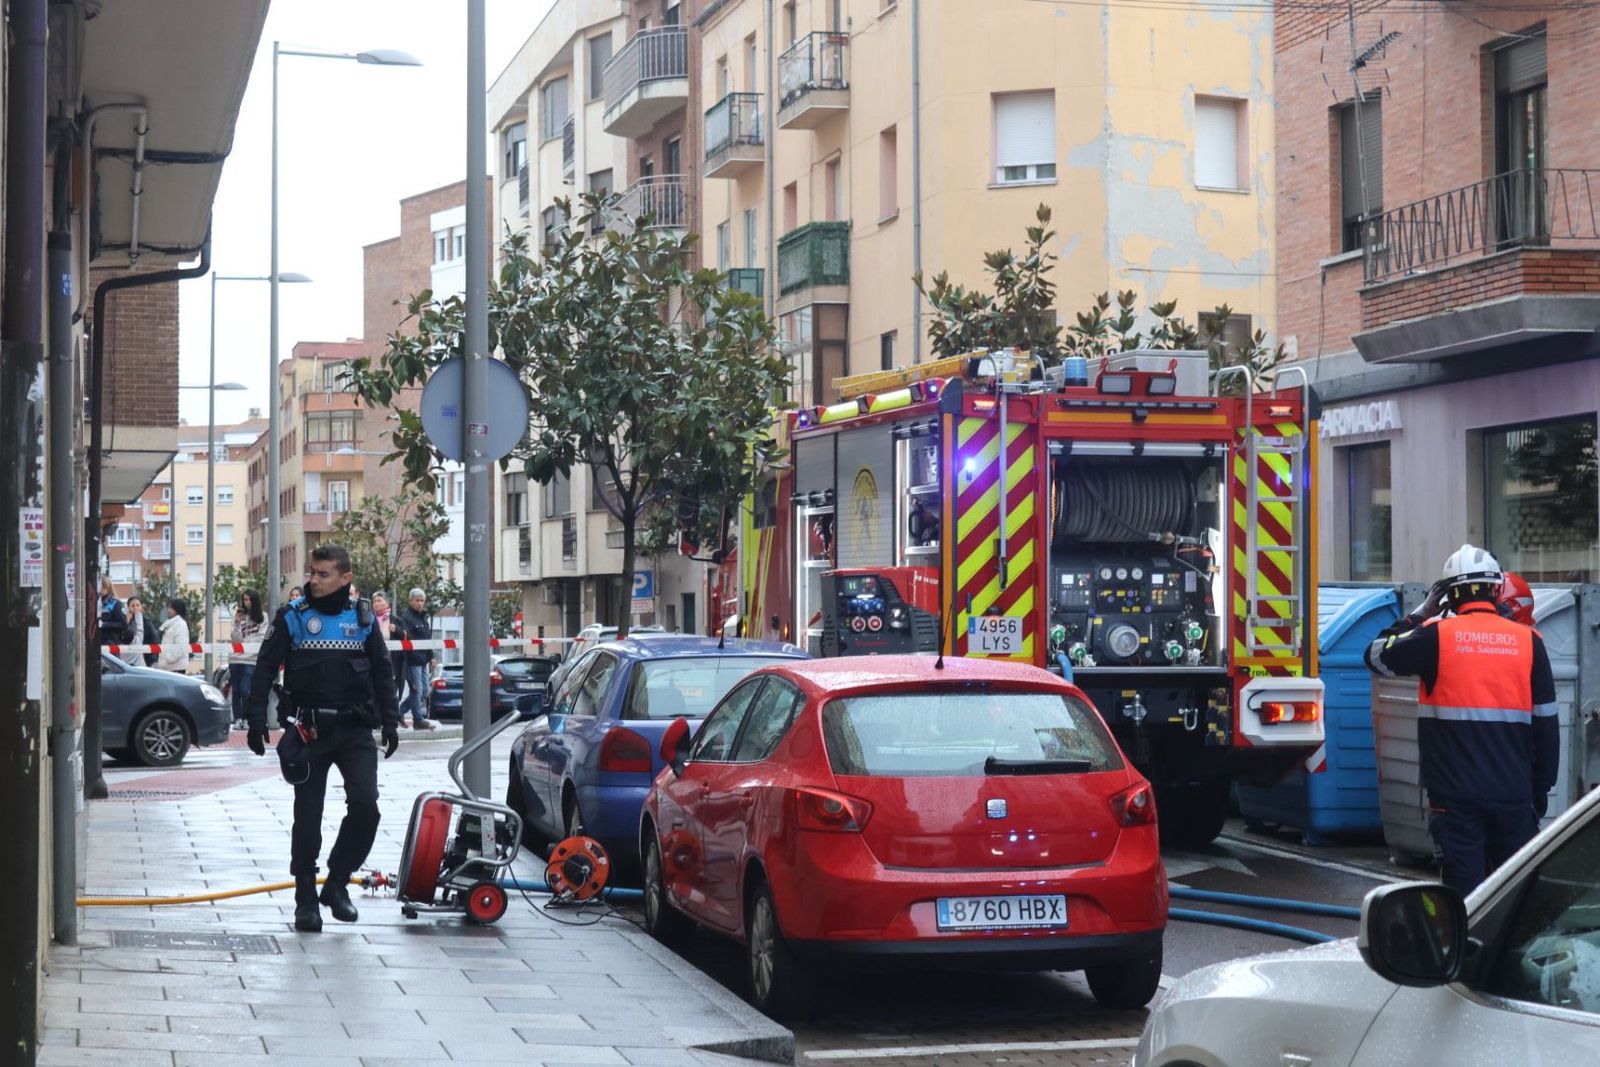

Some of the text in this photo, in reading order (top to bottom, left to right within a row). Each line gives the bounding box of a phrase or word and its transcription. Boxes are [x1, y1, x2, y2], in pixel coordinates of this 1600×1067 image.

[980, 619, 1017, 633] 4956
[983, 636, 1011, 650] LYS
[1455, 631, 1517, 646] BOMBEROS
[953, 899, 1061, 922] 8760 HBX
